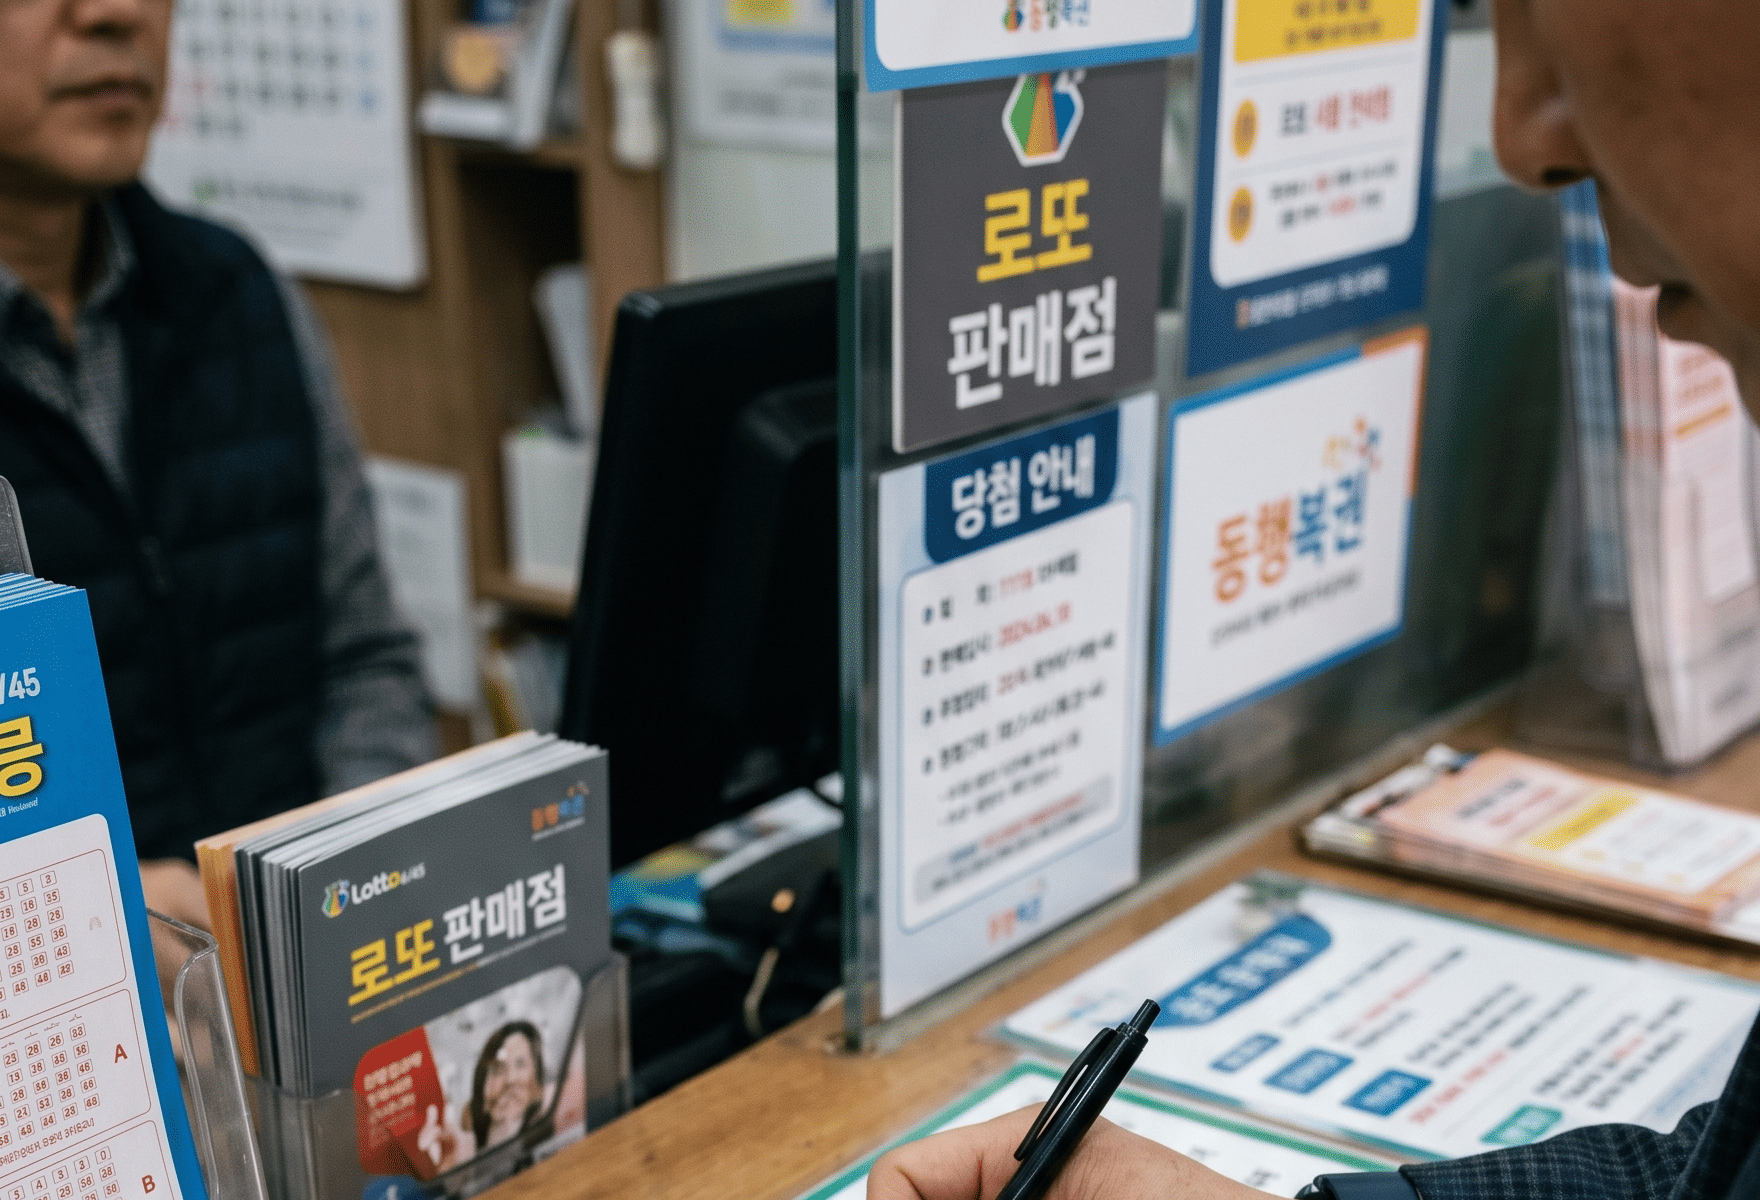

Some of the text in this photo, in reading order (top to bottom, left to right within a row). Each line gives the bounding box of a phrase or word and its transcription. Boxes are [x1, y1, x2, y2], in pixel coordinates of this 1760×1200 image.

[976, 178, 1093, 283] 로또
[947, 275, 1117, 410] 판매점
[951, 432, 1096, 540] 당첨 안내
[348, 863, 566, 1006] 로또 판매점
[114, 1043, 128, 1064] A
[142, 1175, 156, 1194] B
